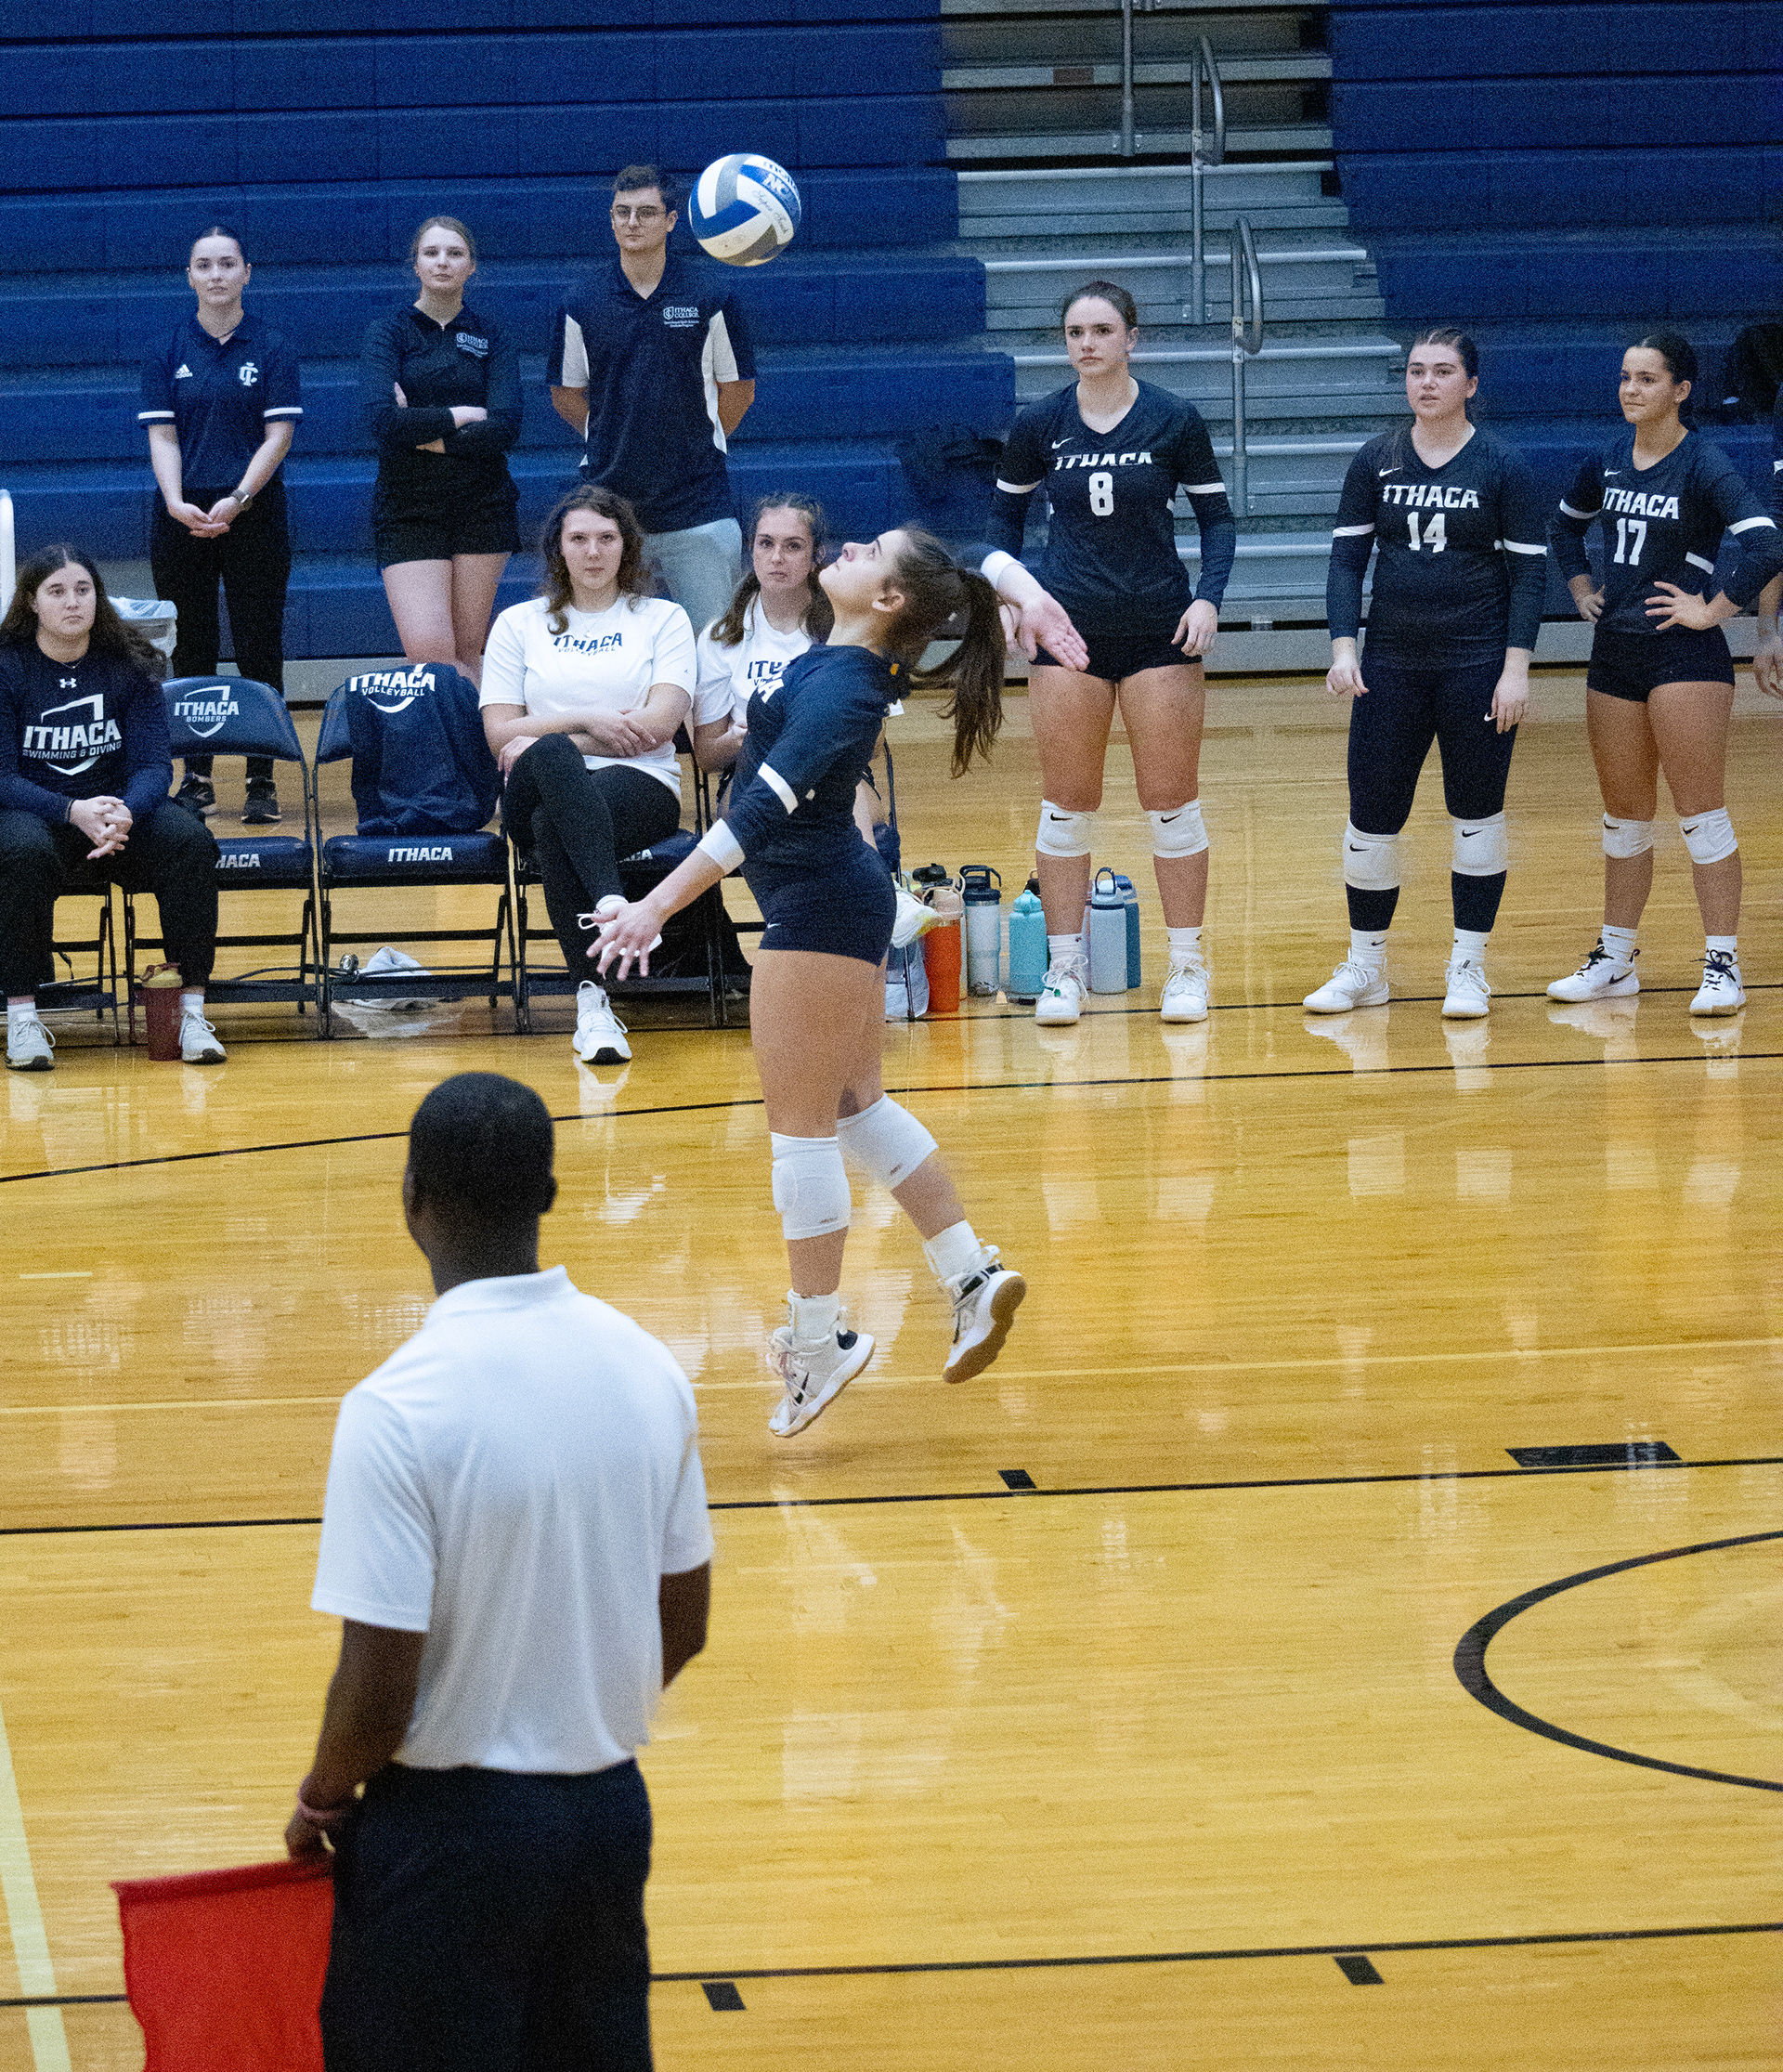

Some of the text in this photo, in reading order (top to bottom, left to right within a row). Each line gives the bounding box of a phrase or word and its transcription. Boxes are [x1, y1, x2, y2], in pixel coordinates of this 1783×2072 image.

[1054, 451, 1152, 471] ITHACA
[1088, 472, 1114, 516] 8
[1382, 484, 1480, 509] ITHACA
[1602, 487, 1680, 520] ITHACA
[1407, 511, 1448, 554] 14
[1613, 517, 1647, 566] 17
[553, 632, 623, 652] ITHACA
[350, 671, 436, 692] ITHACA
[361, 685, 425, 697] VOLLEYBALL
[174, 701, 240, 716] ITHACA
[23, 718, 123, 750] ITHACA
[22, 740, 122, 760] SWIMMING & DIVING
[388, 847, 454, 863] ITHACA
